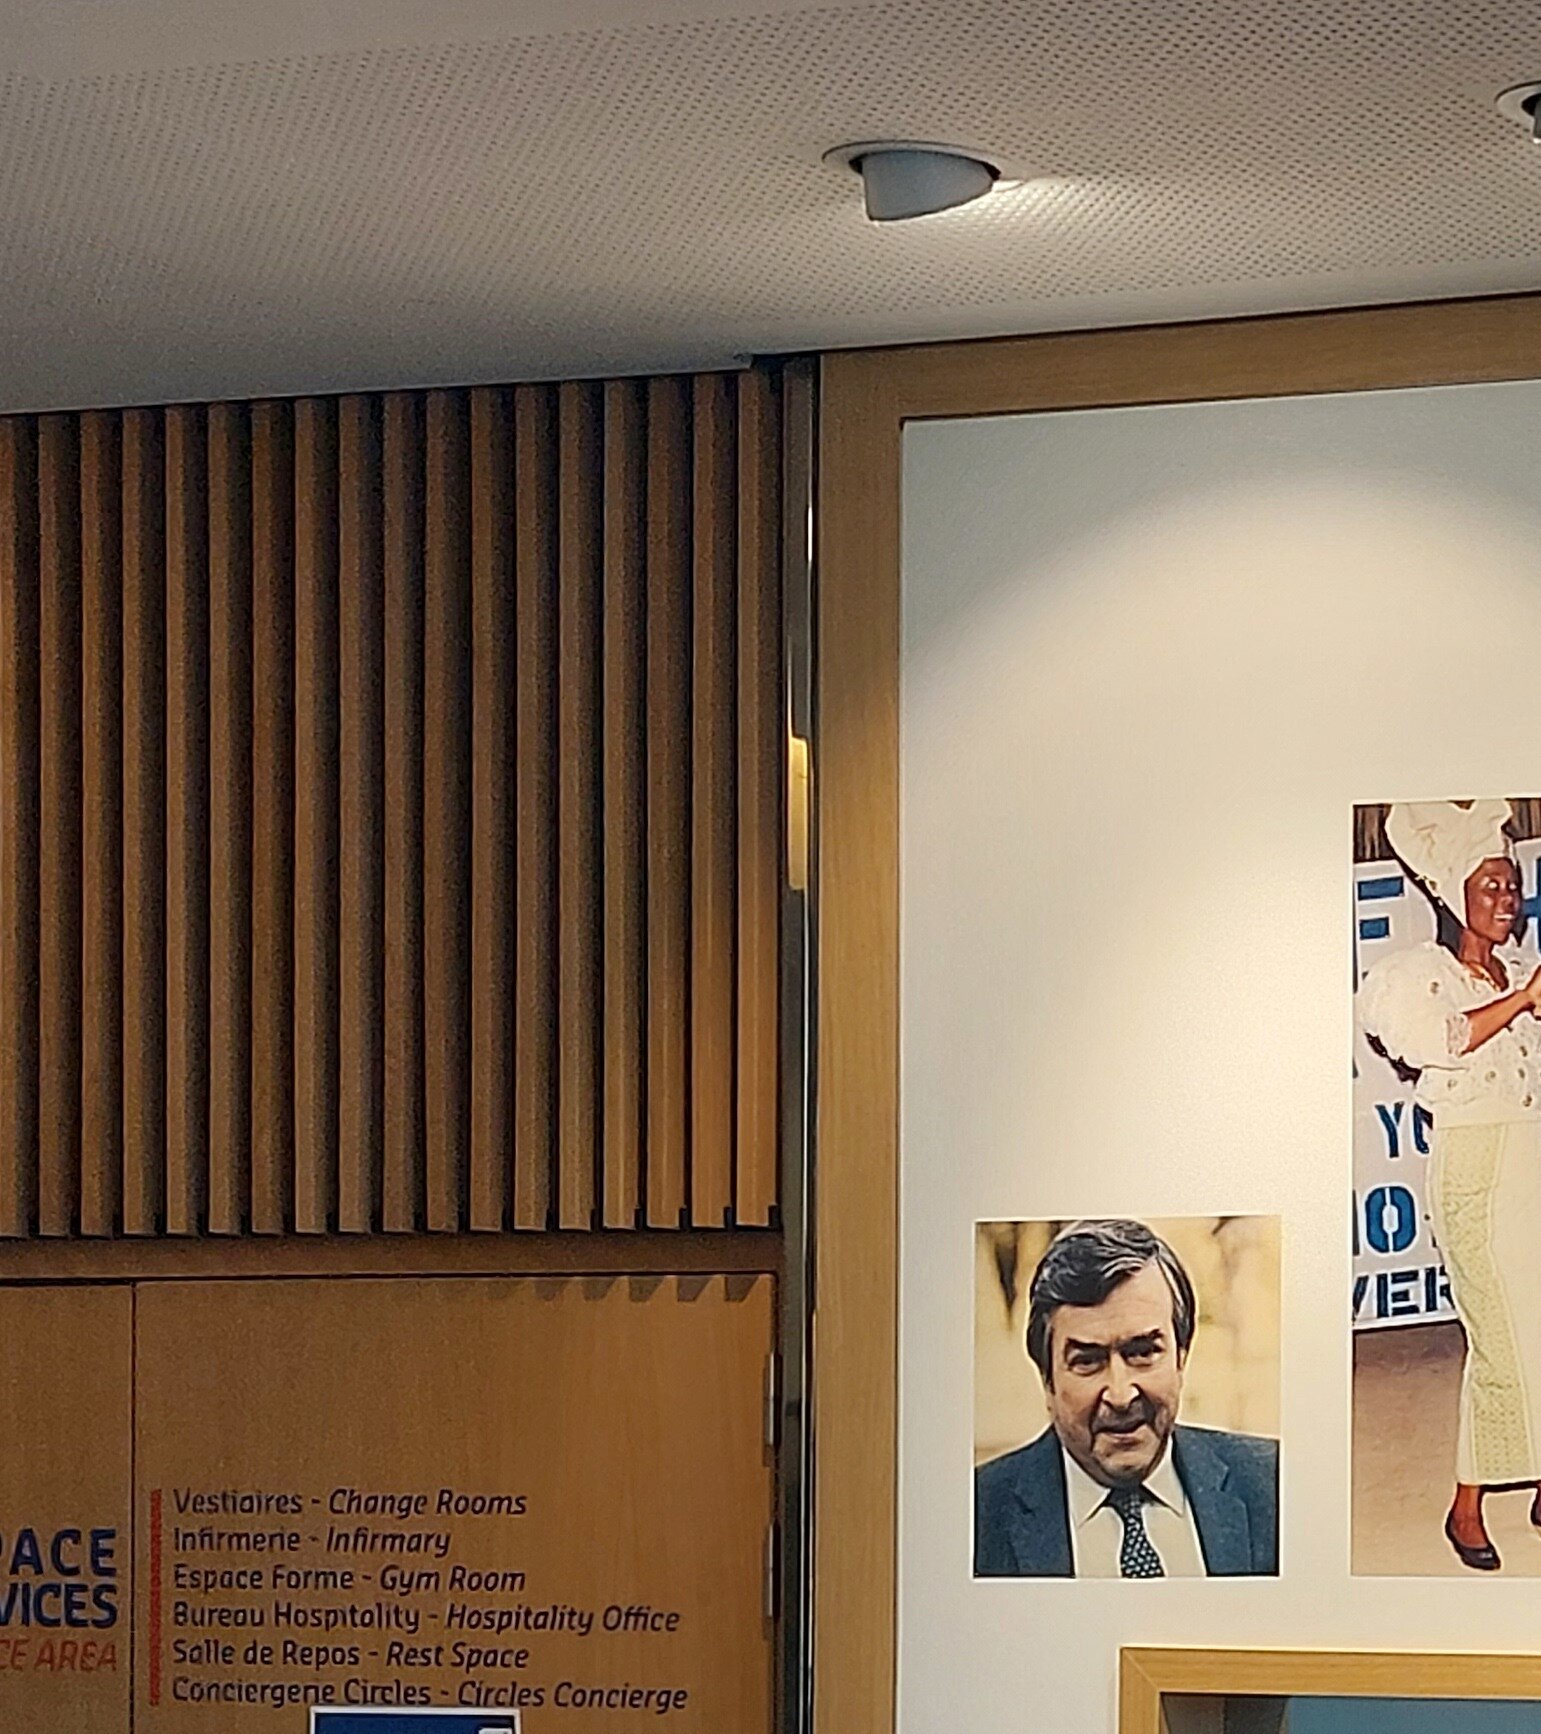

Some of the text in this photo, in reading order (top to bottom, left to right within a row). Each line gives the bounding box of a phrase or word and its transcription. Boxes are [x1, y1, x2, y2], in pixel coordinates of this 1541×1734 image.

[173, 1488, 303, 1514] Vestiaires
[329, 1489, 427, 1519] Change
[436, 1489, 528, 1515] Rooms
[0, 1528, 118, 1577] ACE
[174, 1527, 301, 1552] Infirmerie
[326, 1527, 450, 1558] Infirmary
[174, 1563, 263, 1594] Espace
[272, 1564, 354, 1590] Forme
[380, 1565, 440, 1596] Gym
[449, 1566, 527, 1592] Room
[173, 1602, 264, 1628] Bureau
[274, 1602, 420, 1634] Hospitality
[446, 1604, 594, 1636] Hospitality
[602, 1605, 680, 1632] Office
[34, 1640, 118, 1672] AREA
[173, 1639, 235, 1665] Salle
[243, 1640, 274, 1665] de
[283, 1640, 360, 1671] Repos
[386, 1641, 445, 1667] Rest
[451, 1642, 529, 1674] Space
[172, 1676, 335, 1708] Conciergerie
[344, 1678, 431, 1706] Circles
[458, 1681, 545, 1707] Circles
[554, 1682, 688, 1714] Concierge
